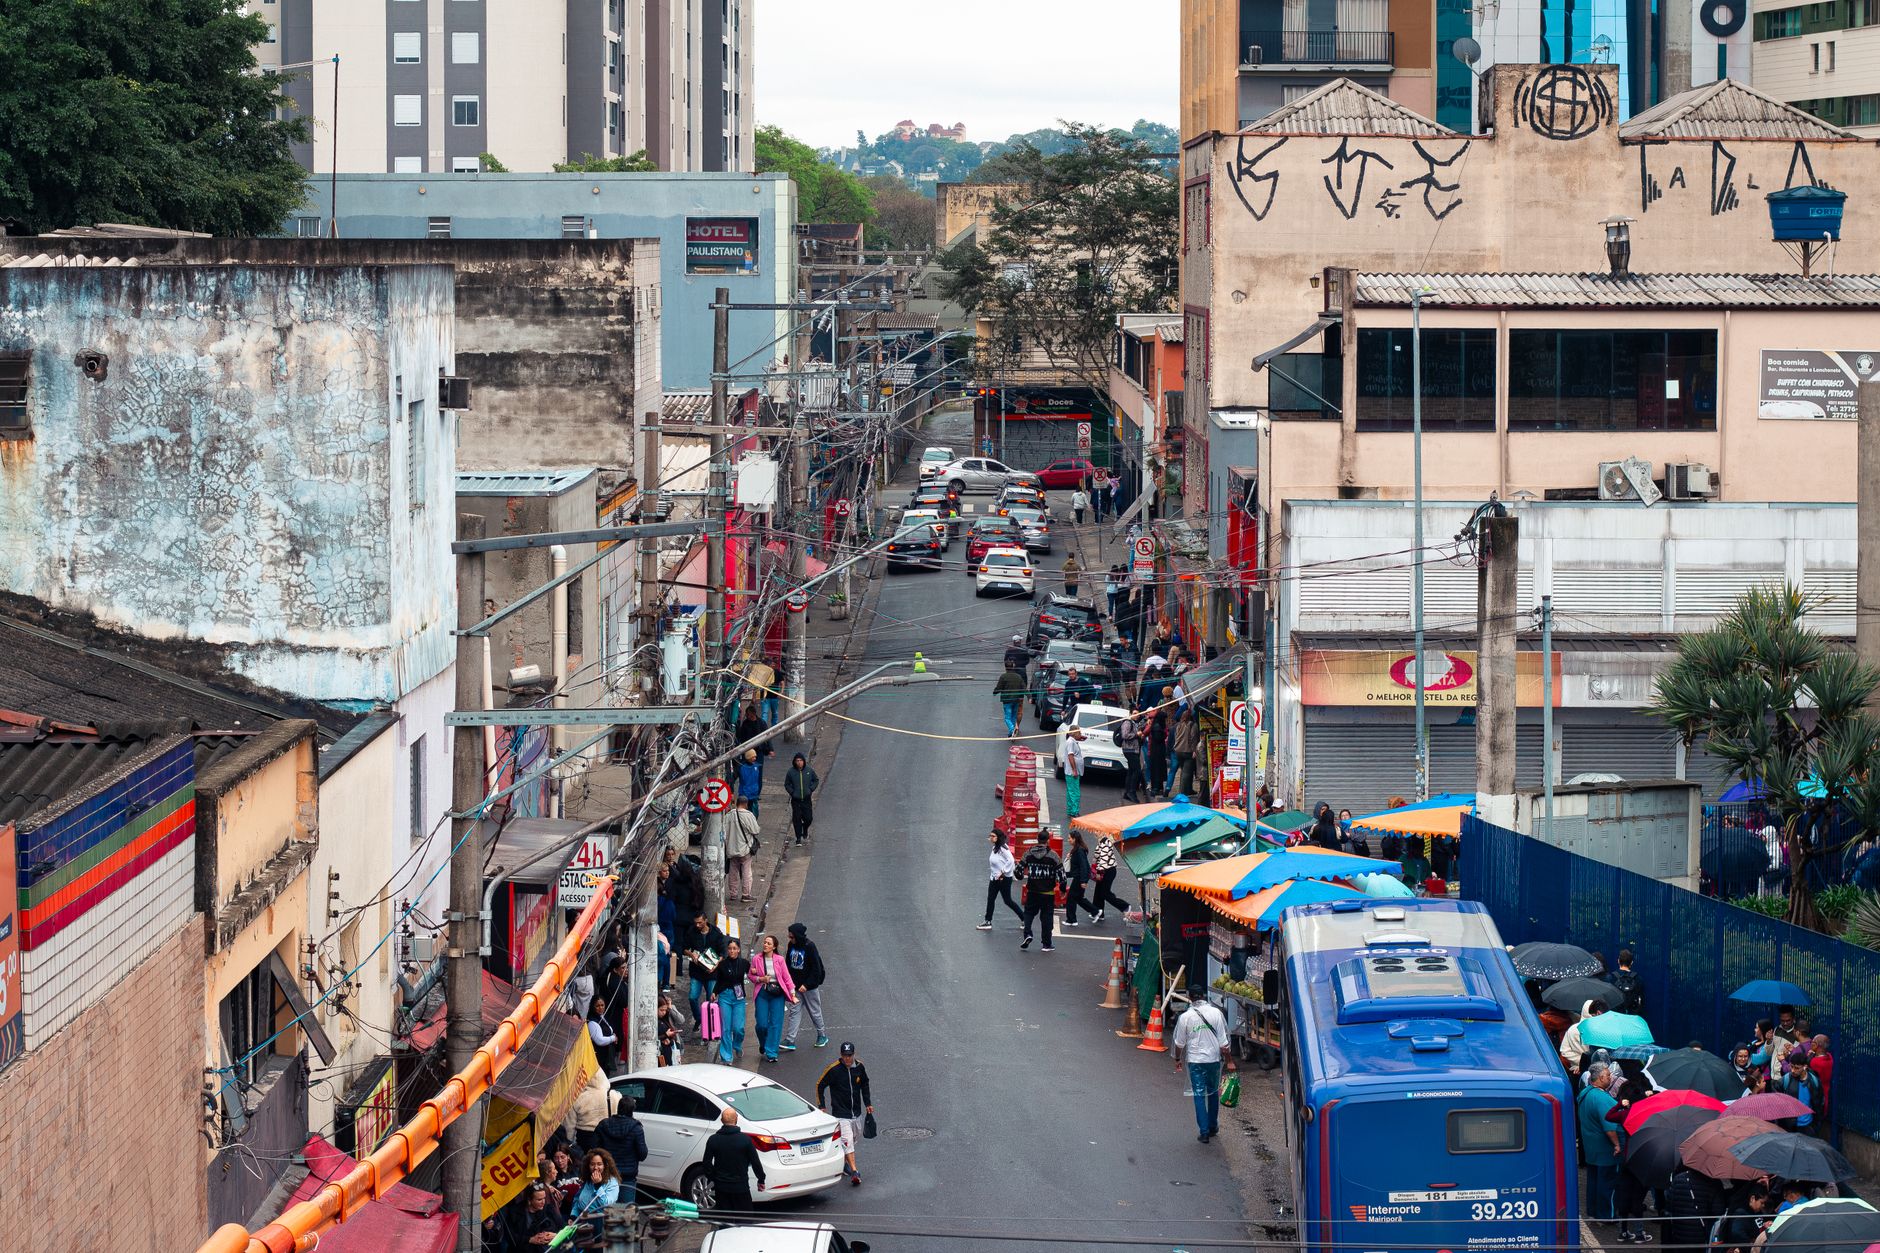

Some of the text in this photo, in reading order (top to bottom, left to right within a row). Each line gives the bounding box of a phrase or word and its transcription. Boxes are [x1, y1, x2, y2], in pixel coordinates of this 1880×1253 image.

[687, 226, 743, 237] HOTEL
[687, 247, 743, 256] PAULISTANO
[1783, 358, 1808, 366] comida
[1798, 379, 1812, 387] COM
[1812, 379, 1844, 387] CHURRASCO
[1768, 388, 1790, 397] DRINKS,
[1048, 398, 1074, 406] Doces
[566, 841, 604, 868] 4h
[560, 894, 586, 903] ACESSO
[1425, 1192, 1448, 1200] 181
[1368, 1204, 1421, 1214] Internorte
[1471, 1200, 1539, 1220] 39.230
